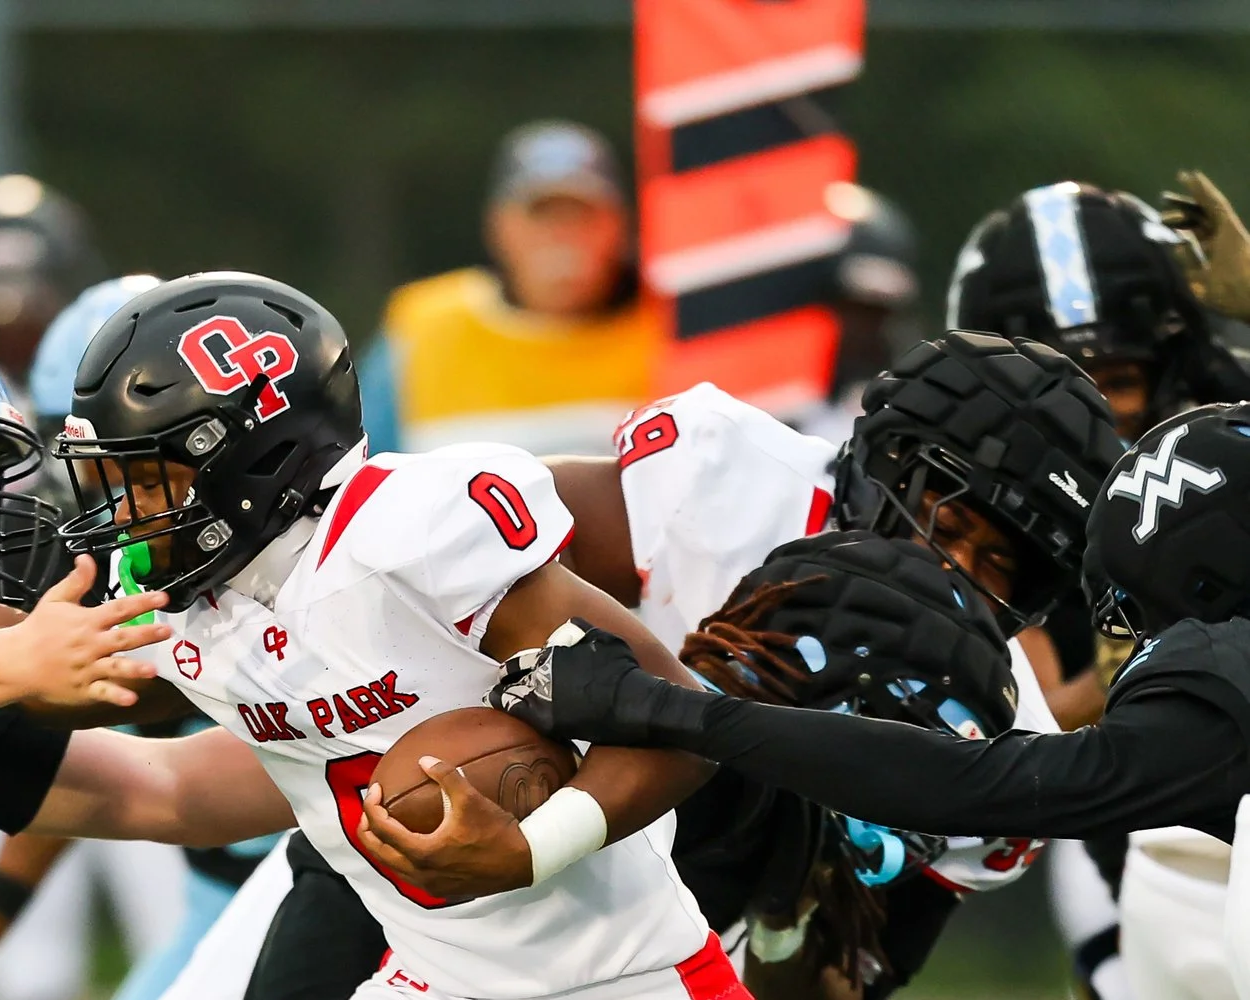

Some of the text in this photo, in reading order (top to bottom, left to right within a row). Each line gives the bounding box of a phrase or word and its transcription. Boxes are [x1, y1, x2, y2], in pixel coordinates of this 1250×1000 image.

[177, 315, 299, 423] OP
[468, 471, 538, 551] 0
[238, 670, 420, 743] OAK PARK
